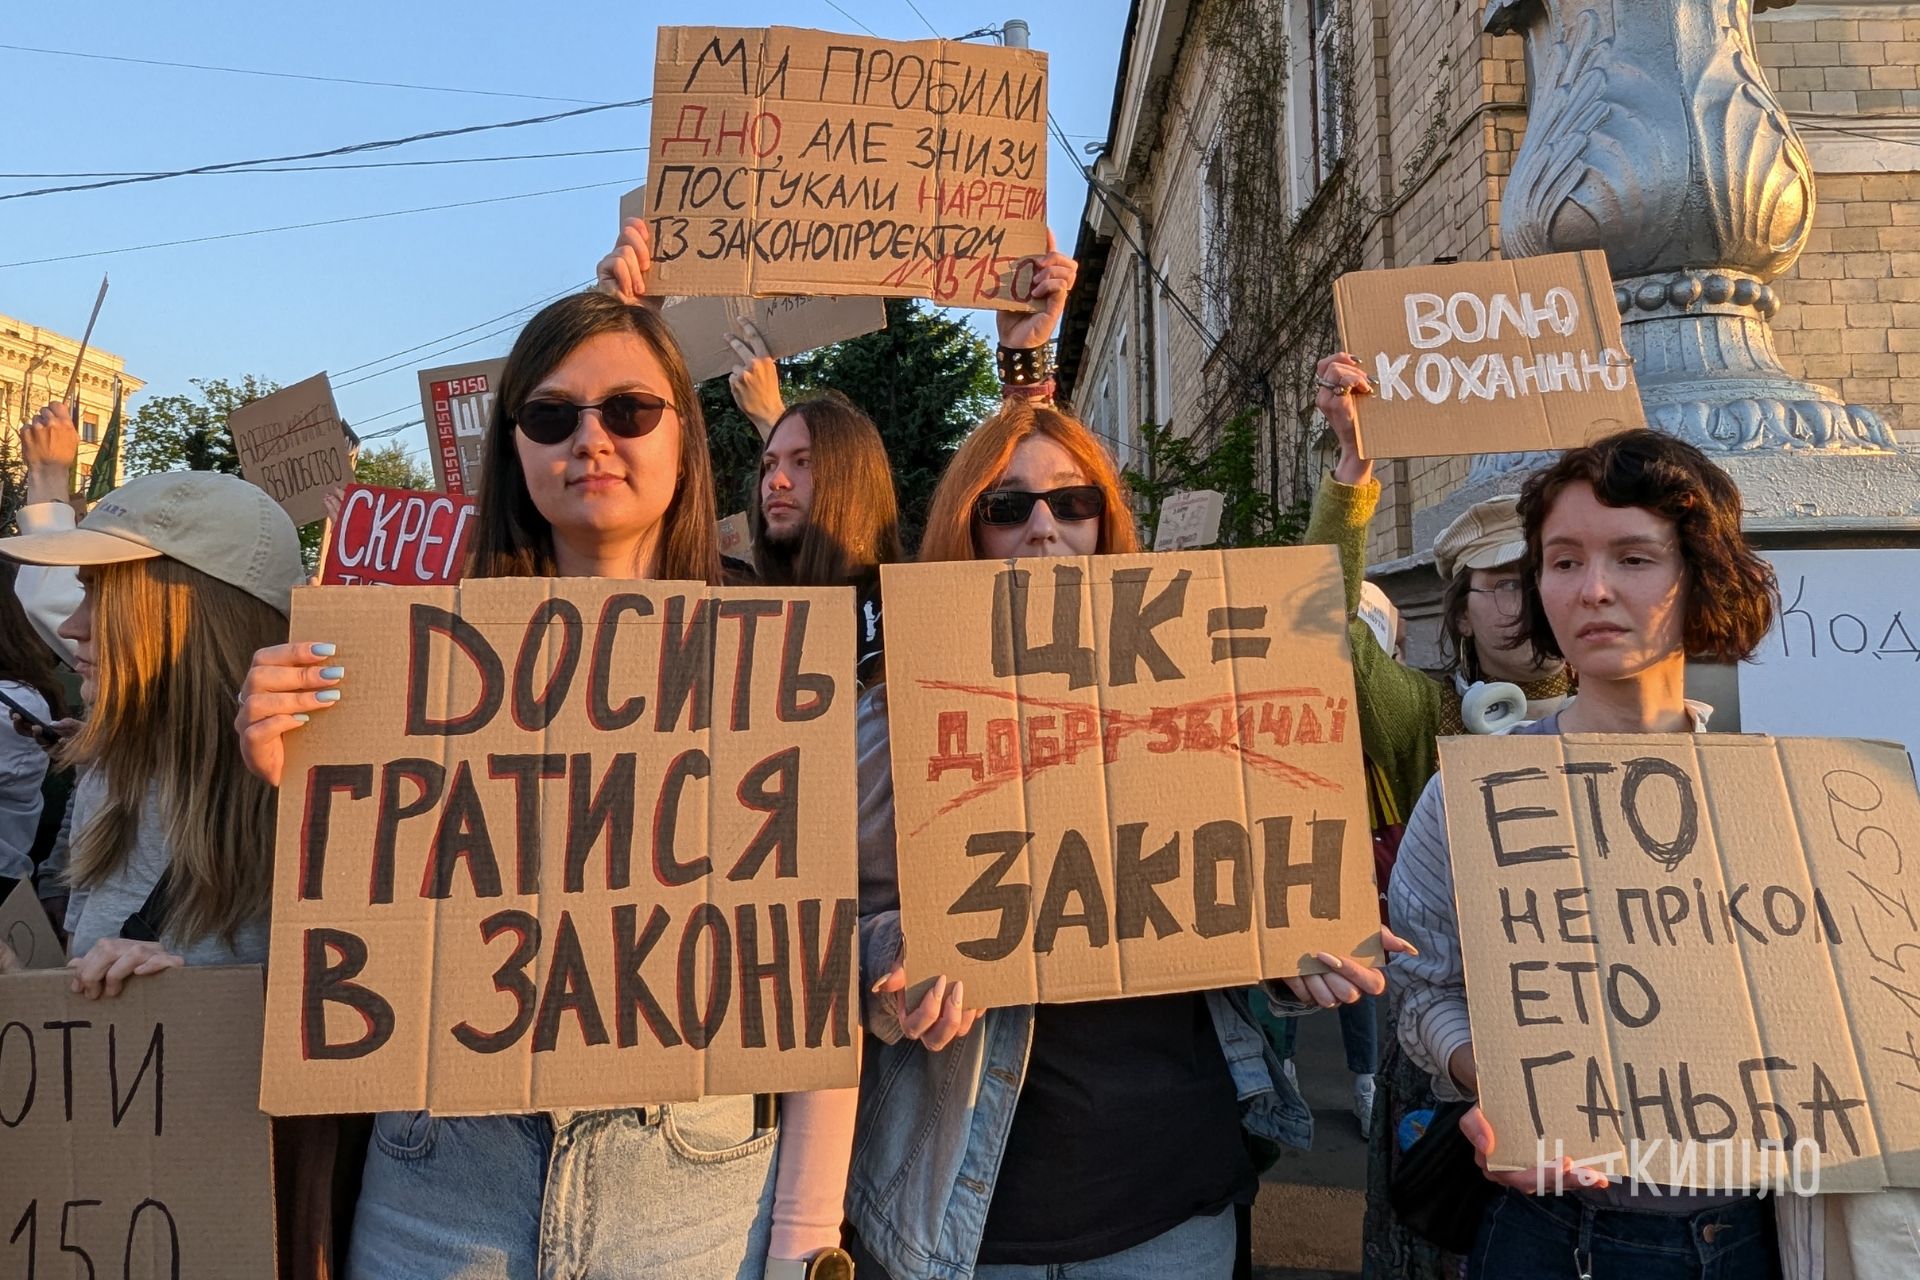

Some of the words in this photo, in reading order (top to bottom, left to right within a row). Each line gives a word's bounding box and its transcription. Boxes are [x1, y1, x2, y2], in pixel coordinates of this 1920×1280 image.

[684, 36, 790, 100] МИ
[820, 46, 1044, 123] ПРОБИЛИ
[661, 104, 783, 166] ДНО,
[798, 118, 893, 164] АЛЕ
[906, 126, 1038, 181] ЗНИЗУ
[654, 165, 899, 212] ПОСТУКАЛИ
[918, 175, 1046, 223] НАРДЕПИ
[697, 218, 1007, 264] ЗАКОНОПРОЄКТОМ
[1404, 286, 1579, 349] ВОЛЮ
[448, 377, 488, 396] 15150
[1375, 348, 1628, 405] КОХАННЮ
[405, 593, 836, 736] ДОСИТЬ
[298, 746, 800, 905] ГРАТИСЯ
[1472, 757, 1698, 872] ЕТО
[947, 809, 1347, 961] ЗАКОН
[1499, 886, 1599, 944] НЕ
[1616, 878, 1843, 945] ПРІКОЛ
[303, 928, 395, 1060] В
[451, 899, 857, 1054] ЗАКОНИ
[1510, 961, 1660, 1028] ЕТО
[0, 1021, 164, 1136] ОТИ
[1521, 1051, 1867, 1156] ГАНЬБА
